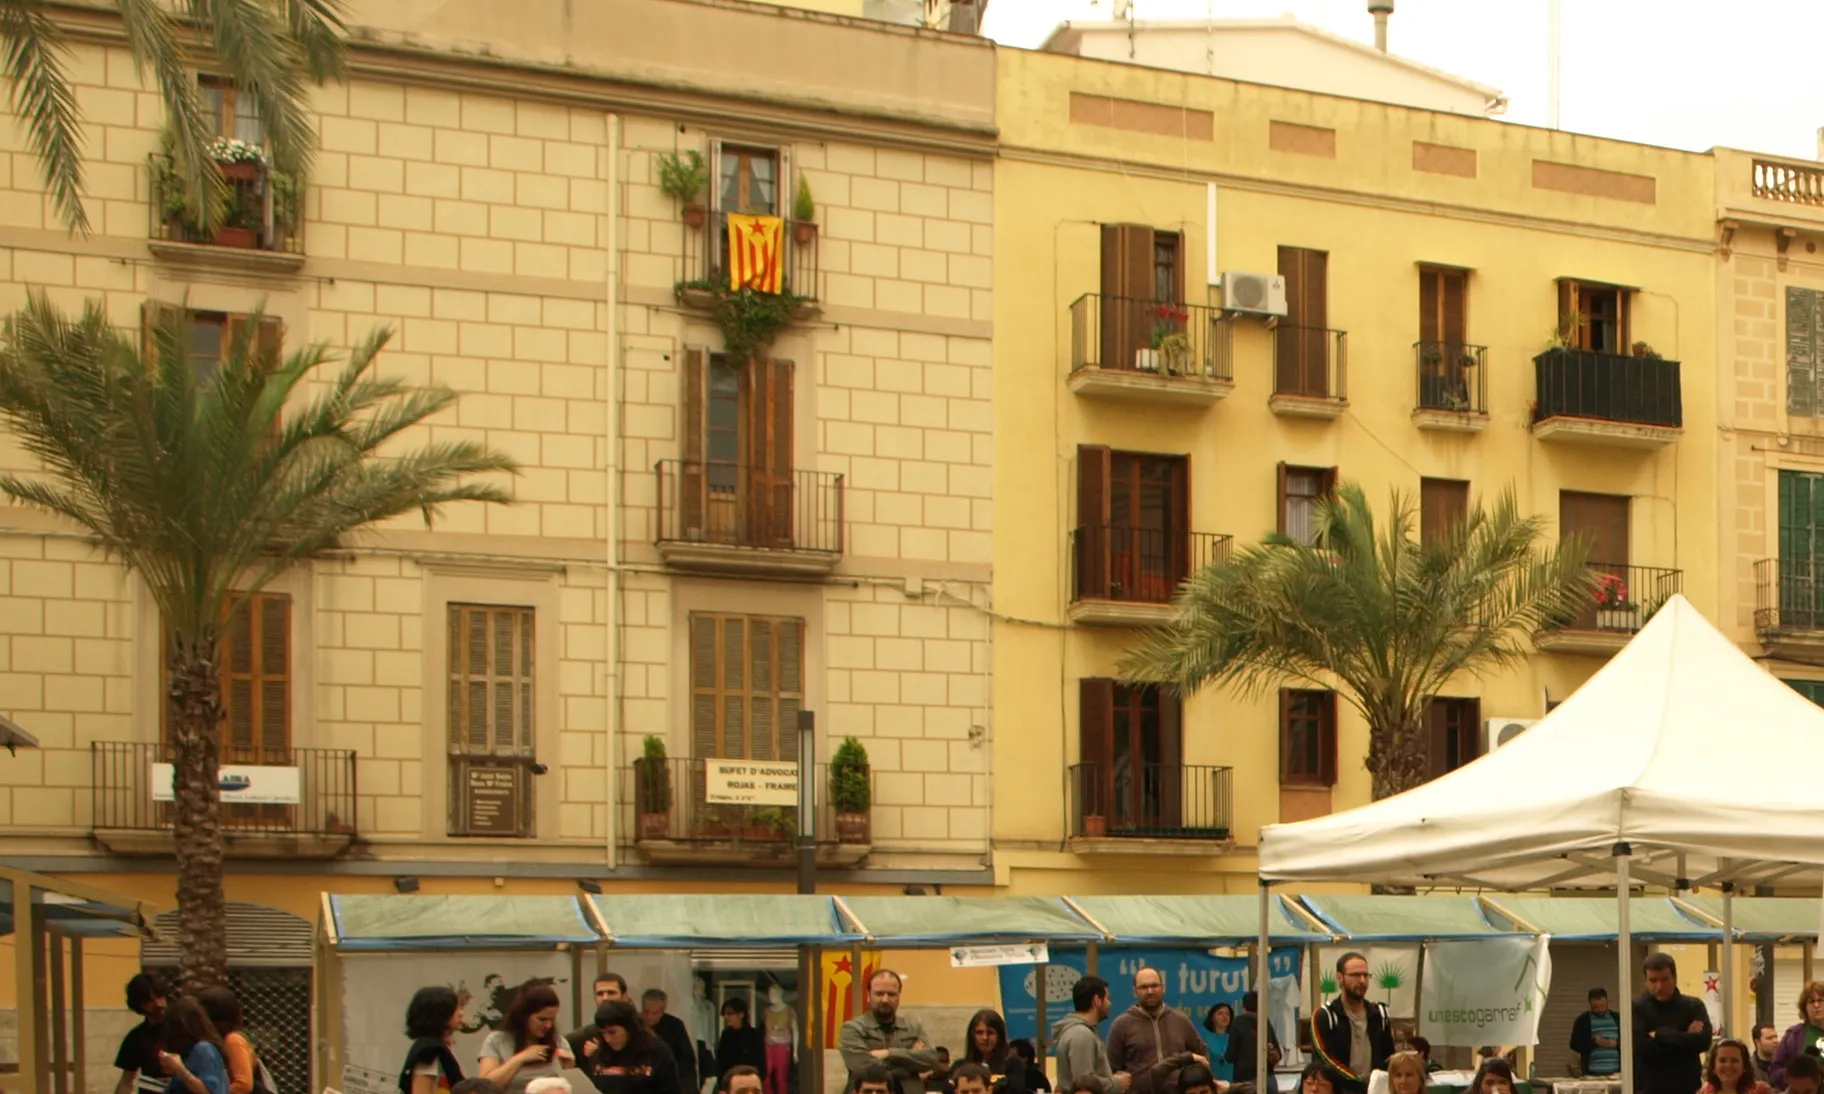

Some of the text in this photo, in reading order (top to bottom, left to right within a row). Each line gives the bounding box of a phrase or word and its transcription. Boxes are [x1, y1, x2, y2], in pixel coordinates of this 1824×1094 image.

[718, 766, 747, 775] BUFET
[727, 781, 755, 790] ROJAS
[1428, 1002, 1522, 1028] unescogarraf
